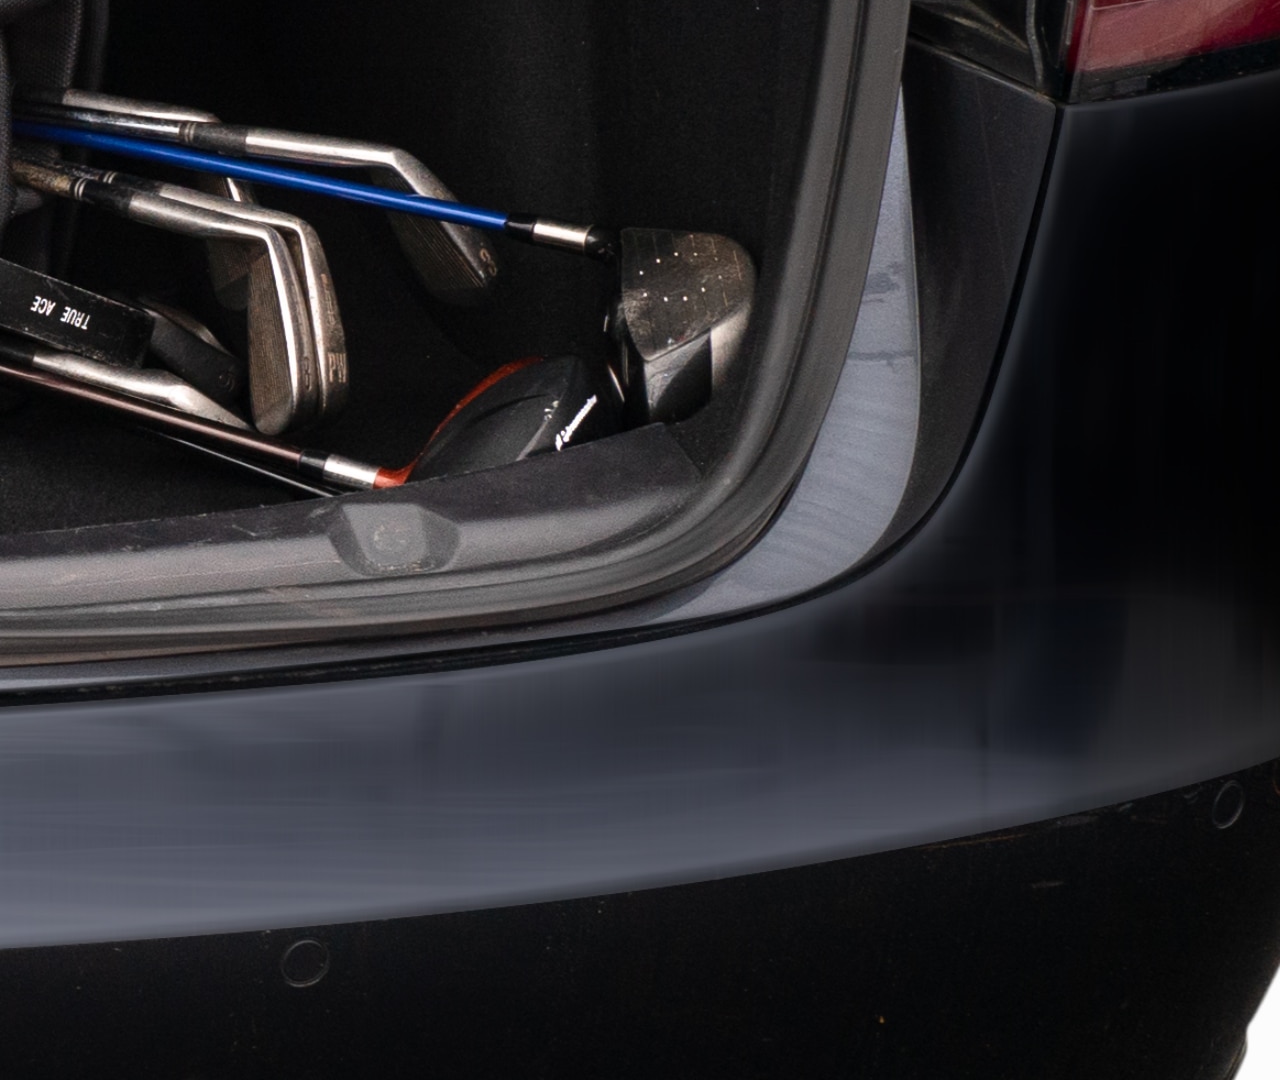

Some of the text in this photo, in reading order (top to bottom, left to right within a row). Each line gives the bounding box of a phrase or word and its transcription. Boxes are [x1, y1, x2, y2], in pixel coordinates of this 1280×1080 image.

[30, 295, 91, 330] TRUE ACE
[327, 352, 347, 384] PW
